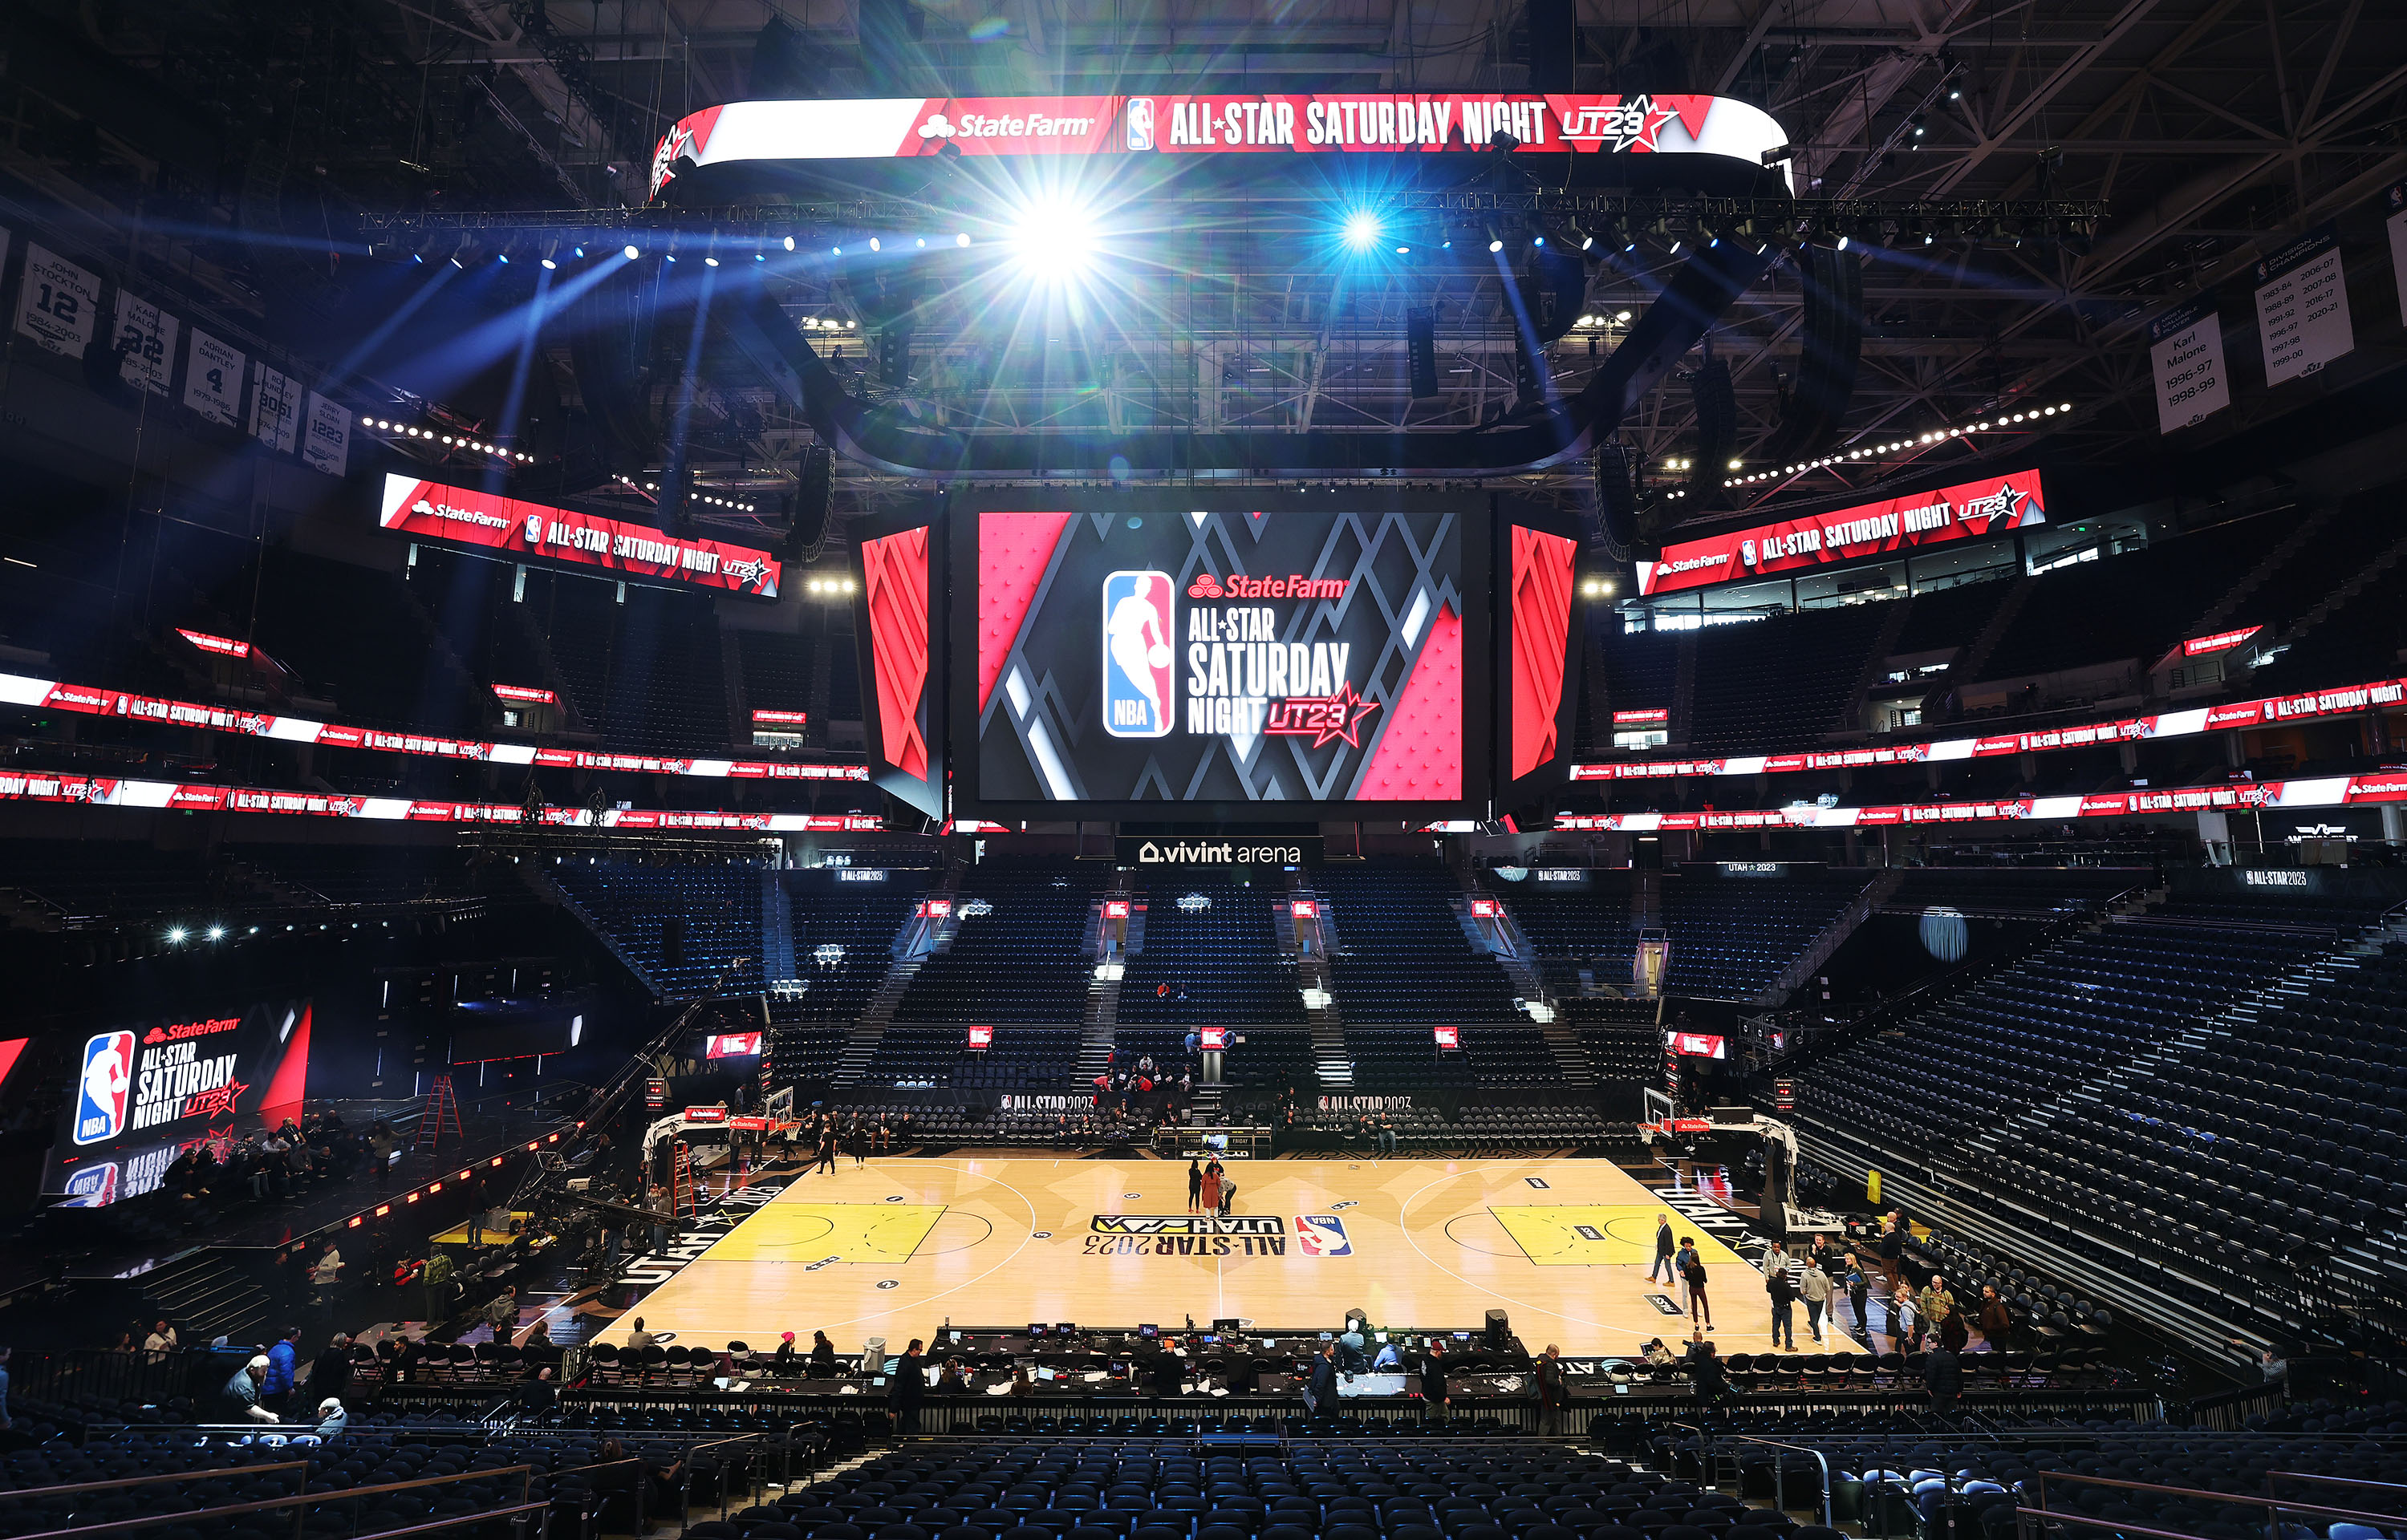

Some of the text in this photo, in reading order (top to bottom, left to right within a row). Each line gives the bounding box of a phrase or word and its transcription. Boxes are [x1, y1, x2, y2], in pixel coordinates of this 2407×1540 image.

[1306, 101, 1451, 144] SATURDAY
[1462, 101, 1547, 144] NIGHT
[1561, 111, 1645, 135] UT23
[2268, 237, 2312, 265] DIVISION
[2269, 235, 2331, 272] CHAMPIONS
[33, 263, 91, 299] STOCKTON
[50, 261, 79, 280] JOHN
[2300, 257, 2334, 282] 2006-07
[2303, 272, 2336, 295] 2007-08
[37, 282, 79, 325] 12
[2161, 308, 2182, 322] MOST
[2307, 302, 2338, 322] 2020-21
[26, 311, 81, 342] 1984-2003
[2162, 306, 2198, 328] VALUABLE
[2162, 316, 2190, 334] PLAYER
[124, 325, 164, 366] 32
[203, 340, 234, 360] ADRIAN
[2173, 331, 2196, 351] Karl
[198, 346, 236, 371] DANTLEY
[2166, 343, 2207, 369] Malone
[206, 368, 223, 394] 4
[2165, 359, 2213, 390] 1996-97
[193, 388, 231, 411] 1979-1986
[2168, 376, 2216, 407] 1998-99
[319, 410, 340, 424] SLOAN
[320, 403, 341, 415] JERRY
[311, 419, 343, 444] 1223
[1958, 496, 2007, 518] UT23
[1825, 513, 1900, 549] SATURDAY
[1903, 501, 1951, 534] NIGHT
[612, 534, 680, 567] SATURDAY
[682, 547, 720, 574] NIGHT
[723, 561, 757, 578] UT23
[1187, 642, 1350, 697] SATURDAY
[2318, 689, 2368, 711] SATURDAY
[2370, 684, 2403, 703] NIGHT
[169, 705, 210, 725] SATURDAY
[1114, 699, 1148, 726] NBA
[1187, 697, 1346, 734] NIGHT UT23
[2062, 728, 2096, 744] SATURDAY
[28, 779, 61, 796] NIGHT
[270, 796, 306, 810] SATURDAY
[306, 798, 327, 811] NIGHT
[2174, 792, 2211, 808] SATURDAY
[2212, 791, 2236, 805] NIGHT
[1941, 806, 1975, 819] SATURDAY
[1236, 846, 1301, 863] arena
[870, 870, 883, 881] 2023
[1567, 871, 1581, 881] 2023
[1728, 864, 1776, 873] UTAH 2023
[2287, 871, 2307, 886] 2023
[136, 1053, 237, 1105] SATURDAY
[132, 1089, 230, 1130] NIGHT UT23
[81, 1114, 106, 1138] NBA
[1653, 1188, 1750, 1228] UTAH
[1193, 1220, 1280, 1234] UTAH
[1311, 1217, 1336, 1225] NBA
[618, 1185, 784, 1284] UTAH 2023
[1581, 1226, 1600, 1240] PASS
[1082, 1236, 1151, 1256] 2023
[1652, 1296, 1678, 1313] PASS
